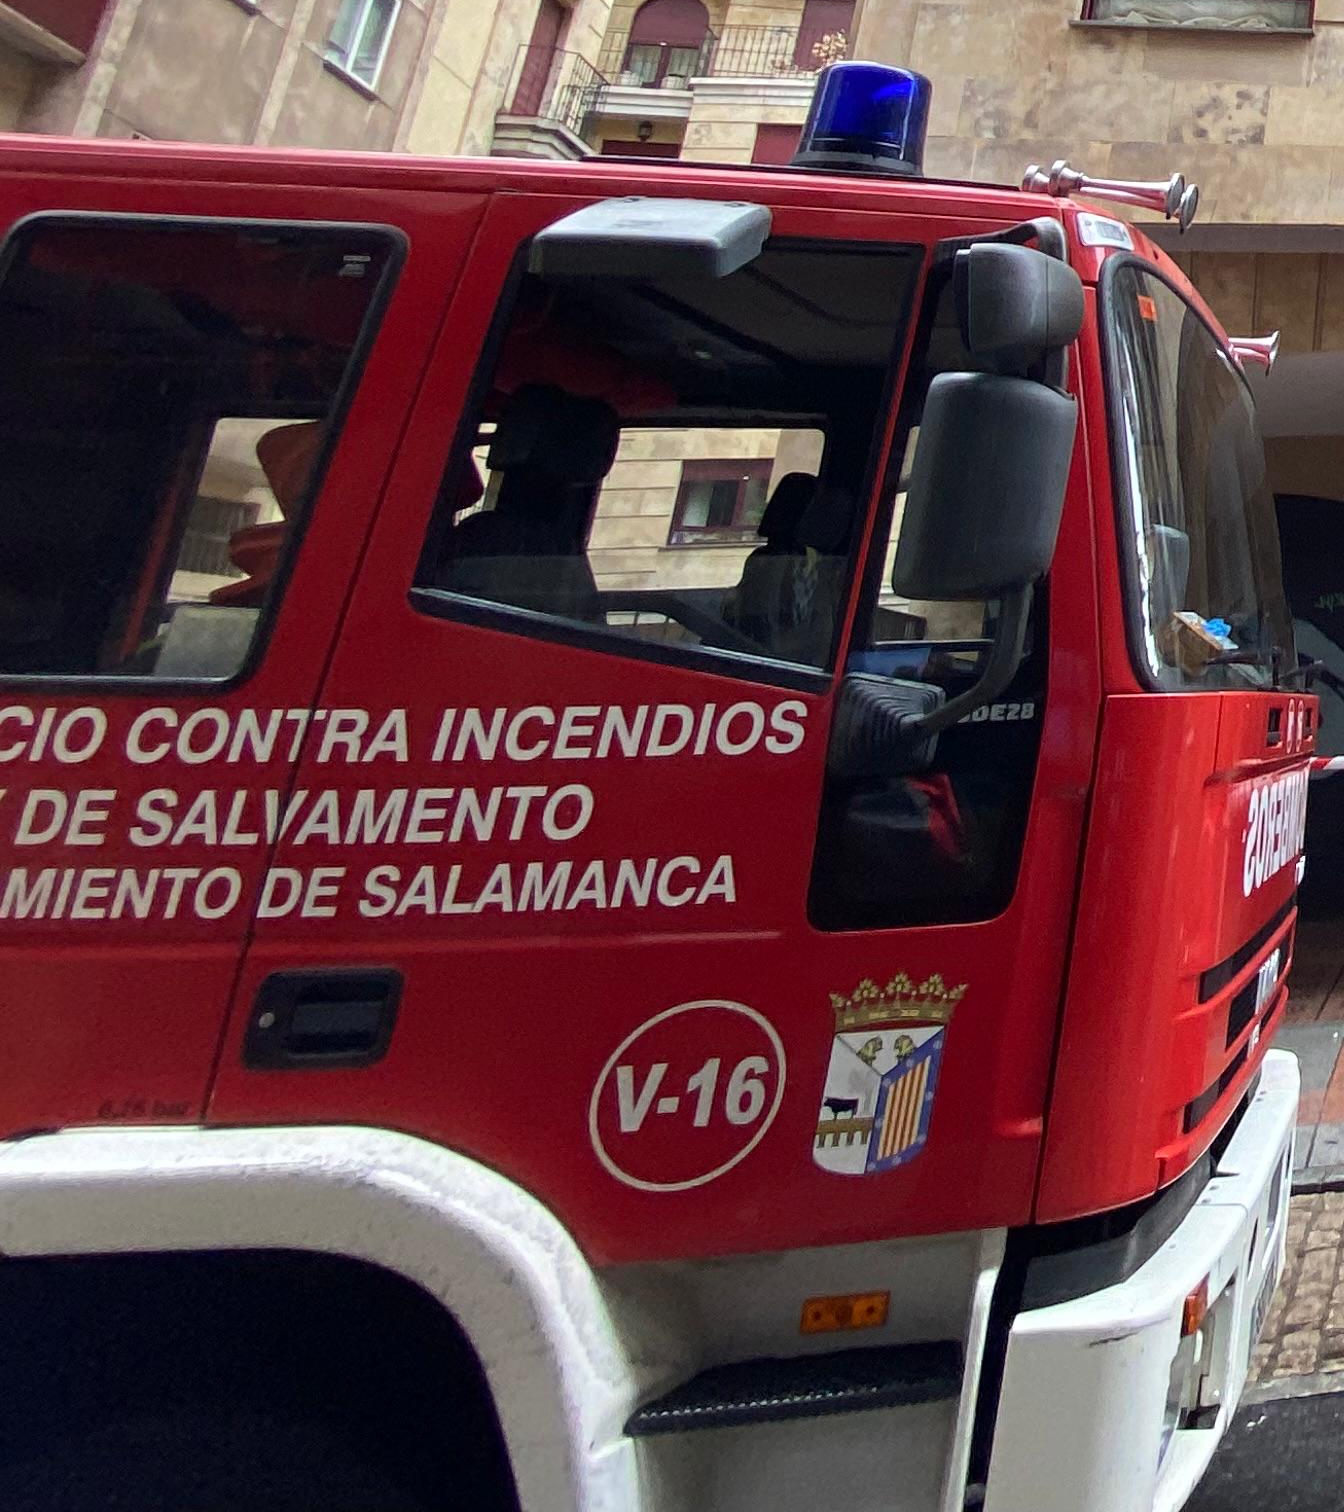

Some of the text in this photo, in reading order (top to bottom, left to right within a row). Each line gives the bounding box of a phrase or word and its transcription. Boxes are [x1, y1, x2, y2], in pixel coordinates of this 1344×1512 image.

[0, 700, 808, 765] CIO CONTRA INCENDIOS
[14, 783, 594, 847] DE SALVAMENTO
[0, 855, 736, 919] MIENTO DE SALAMANCA
[615, 1055, 768, 1134] V-16
